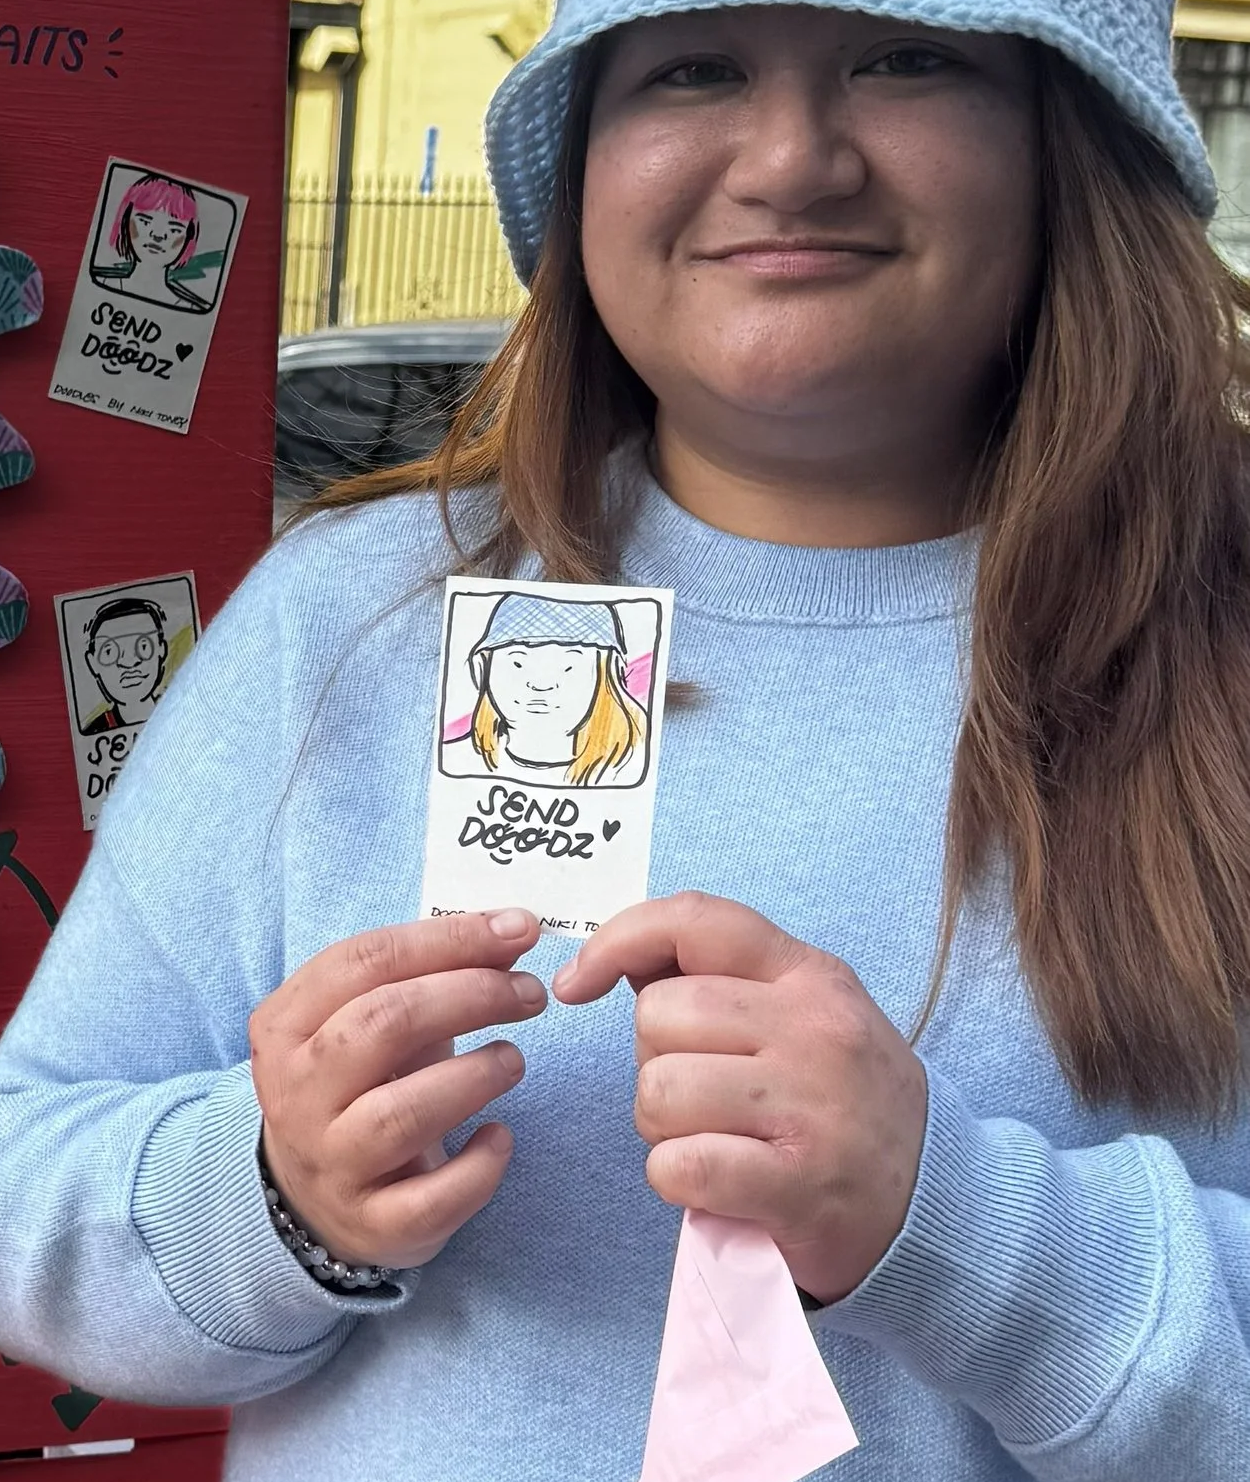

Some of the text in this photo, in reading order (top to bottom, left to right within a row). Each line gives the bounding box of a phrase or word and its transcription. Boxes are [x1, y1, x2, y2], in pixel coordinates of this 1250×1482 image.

[90, 301, 162, 344] SEND
[477, 785, 579, 827] SEND
[458, 817, 594, 859] DOODZ
[539, 917, 578, 931] NIKI
